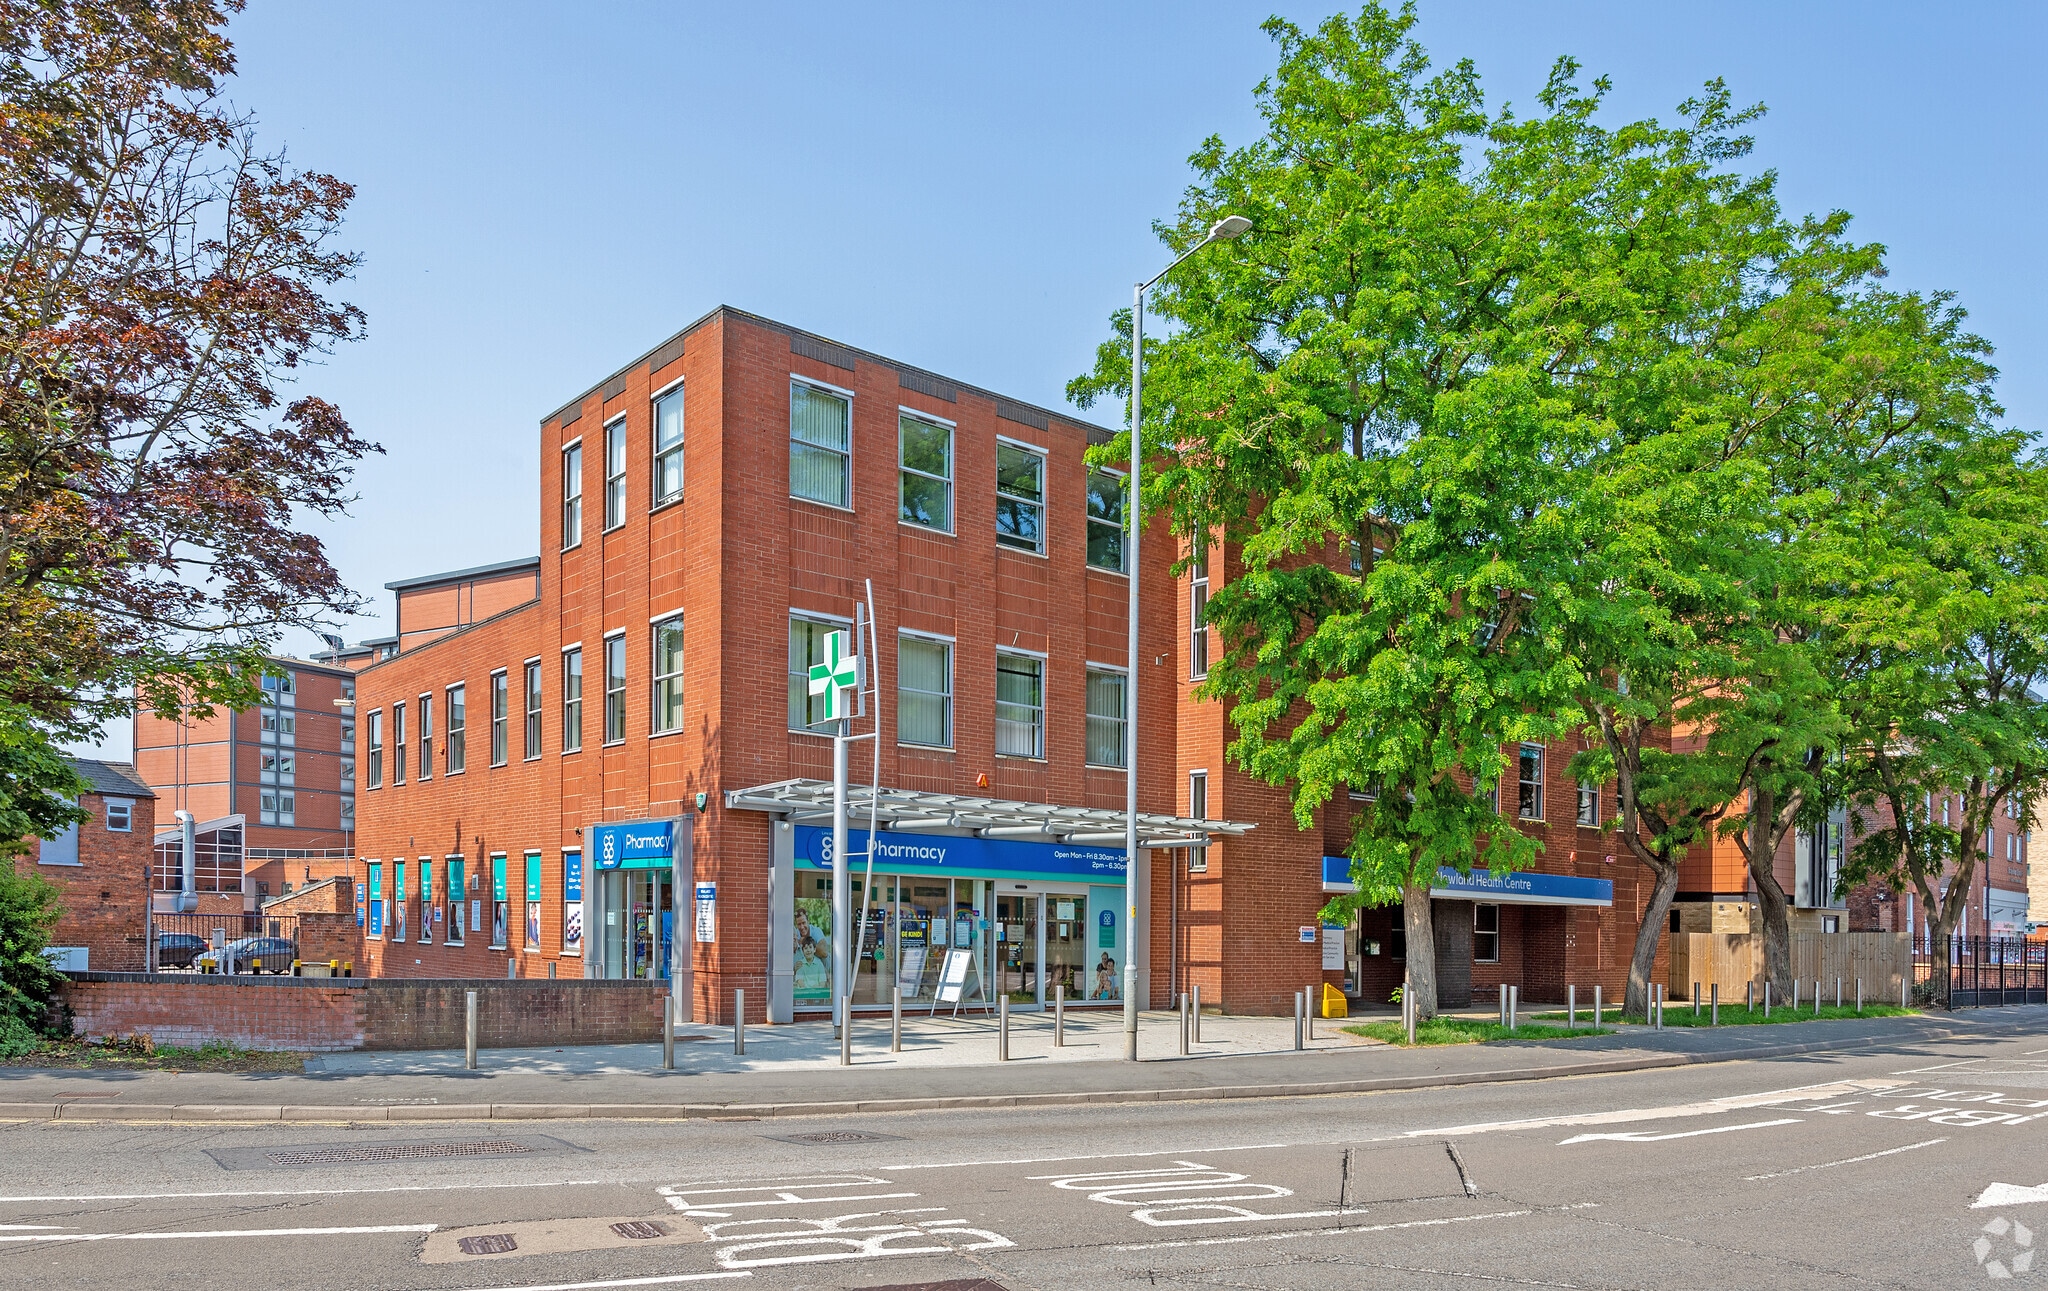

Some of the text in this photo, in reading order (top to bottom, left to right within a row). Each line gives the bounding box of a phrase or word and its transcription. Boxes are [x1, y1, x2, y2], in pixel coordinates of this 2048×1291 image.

[626, 834, 671, 851] Pharmacy
[866, 839, 946, 863] Pharmacy
[1054, 850, 1069, 859] Open
[1070, 851, 1082, 859] Mon
[1094, 853, 1114, 861] 8.30am
[1092, 861, 1104, 869] 2pm
[1476, 874, 1504, 888] Health
[1504, 877, 1532, 890] Centre
[1025, 1161, 1368, 1227] POOL
[655, 1174, 1018, 1269] BR'FD
